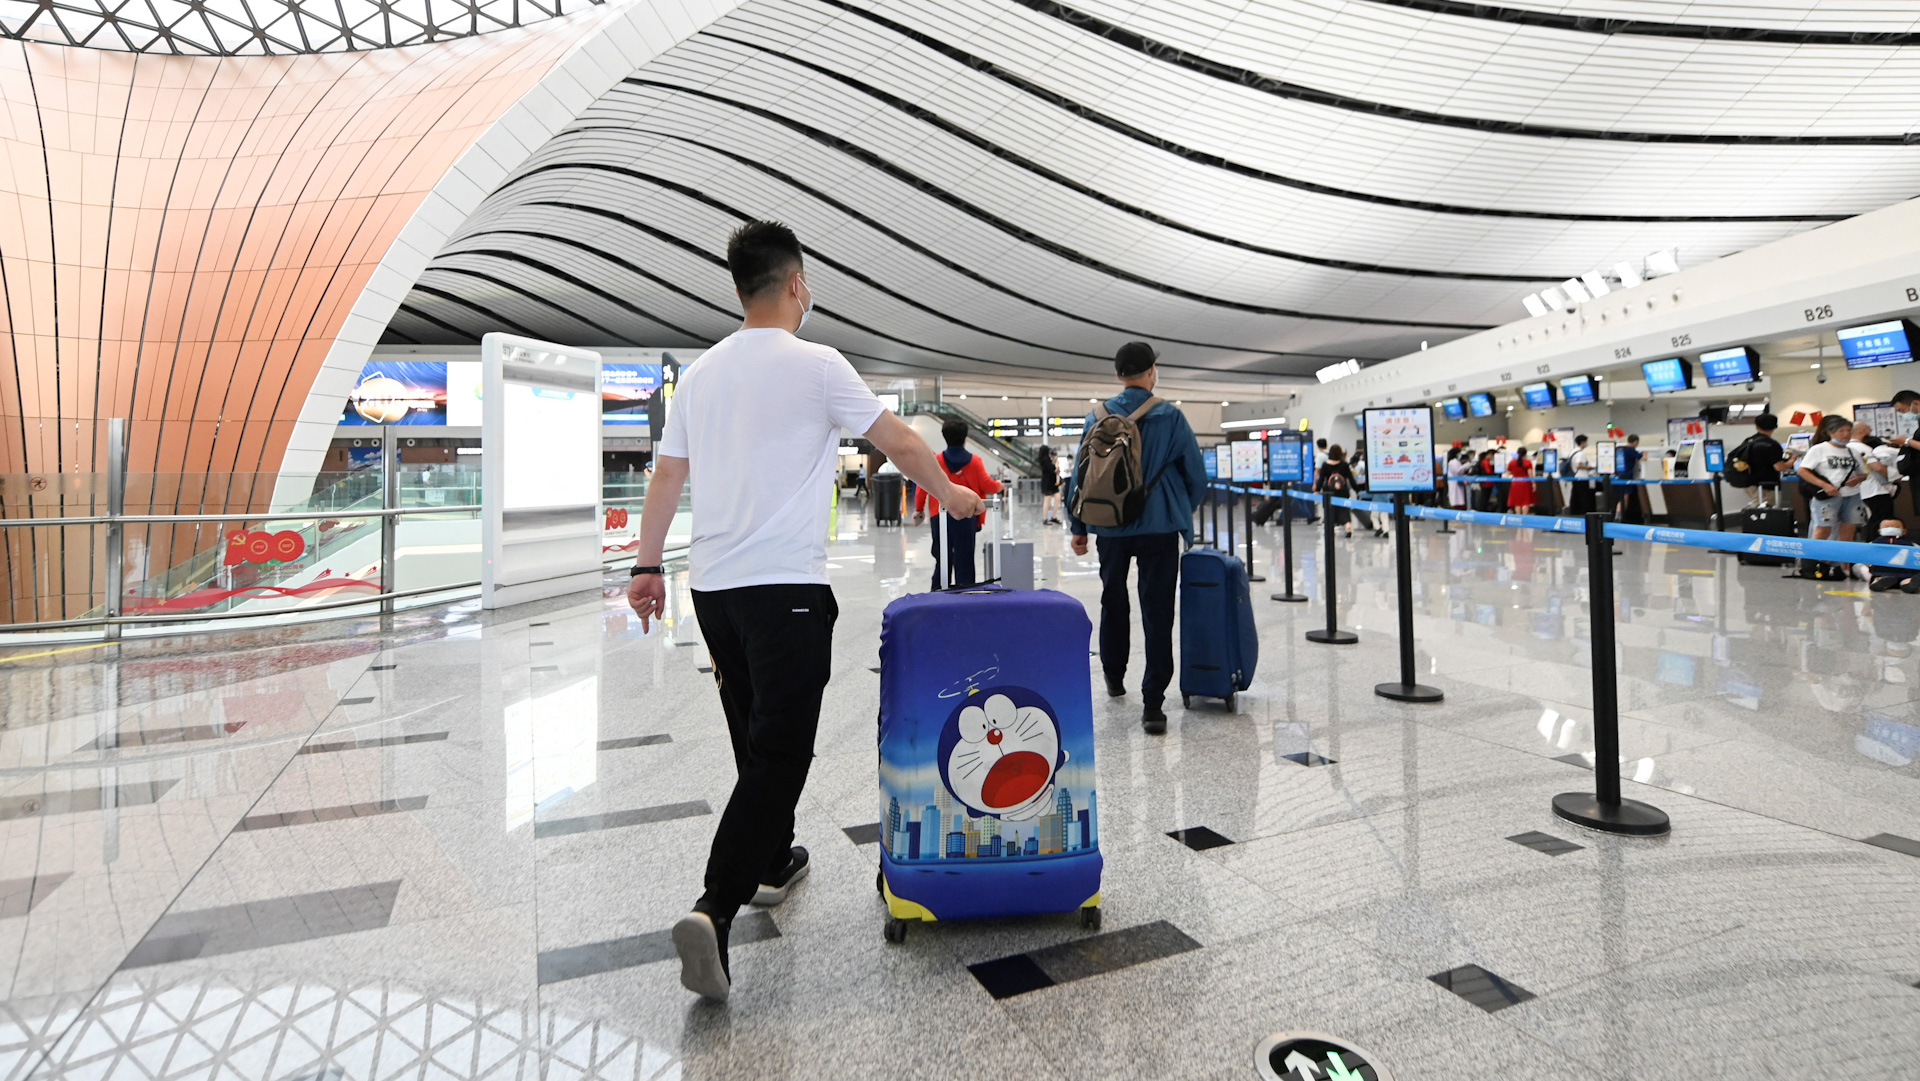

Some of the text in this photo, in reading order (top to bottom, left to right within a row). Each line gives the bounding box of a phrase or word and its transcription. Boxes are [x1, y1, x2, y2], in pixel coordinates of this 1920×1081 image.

[1804, 304, 1834, 322] B26
[1671, 333, 1692, 348] B25
[1614, 346, 1632, 359] B24
[224, 530, 305, 566] 100
